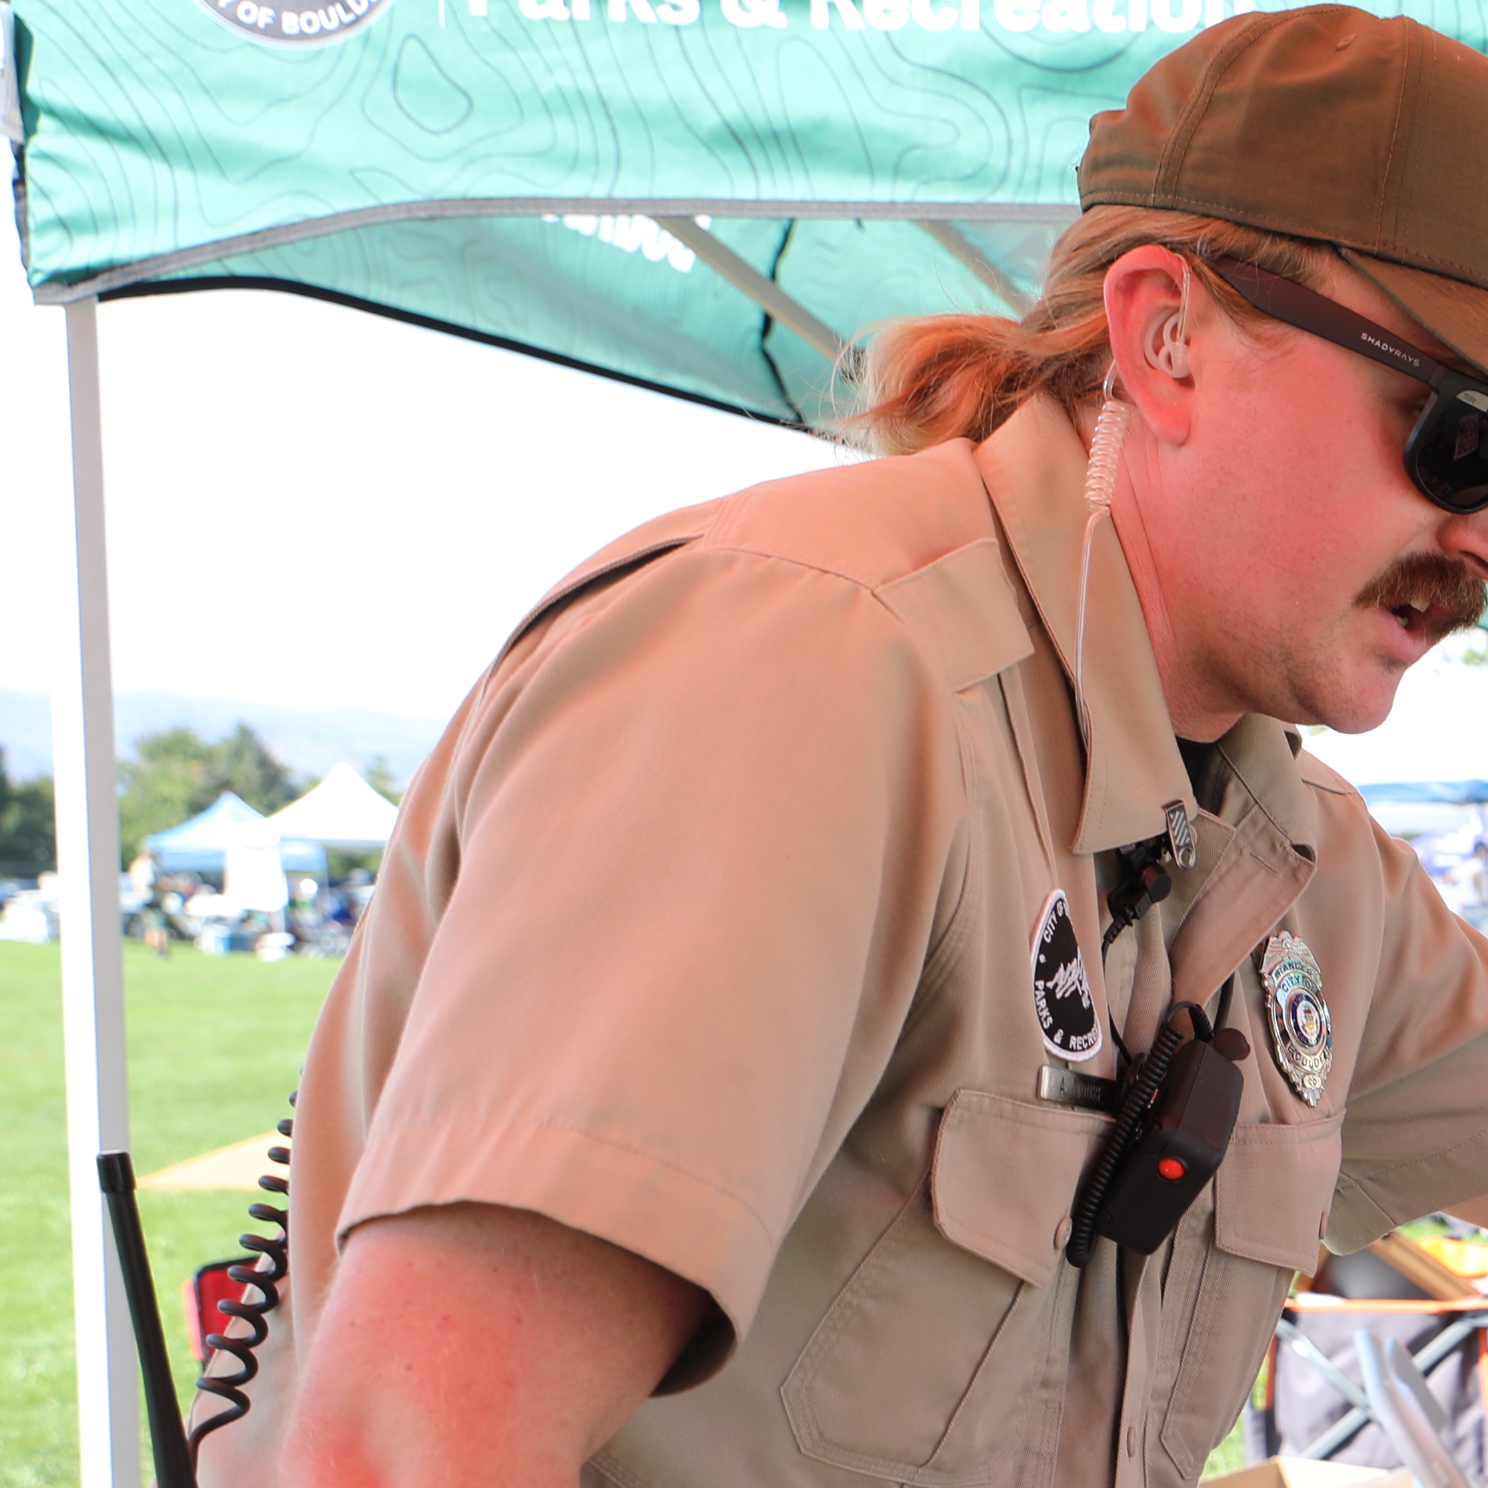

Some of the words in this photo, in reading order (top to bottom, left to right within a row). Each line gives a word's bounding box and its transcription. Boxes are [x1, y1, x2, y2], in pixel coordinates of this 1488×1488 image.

[236, 1, 276, 30] OF
[1043, 913, 1058, 944] CITY
[1281, 973, 1301, 993] CITY
[1034, 980, 1055, 1030] PARKS
